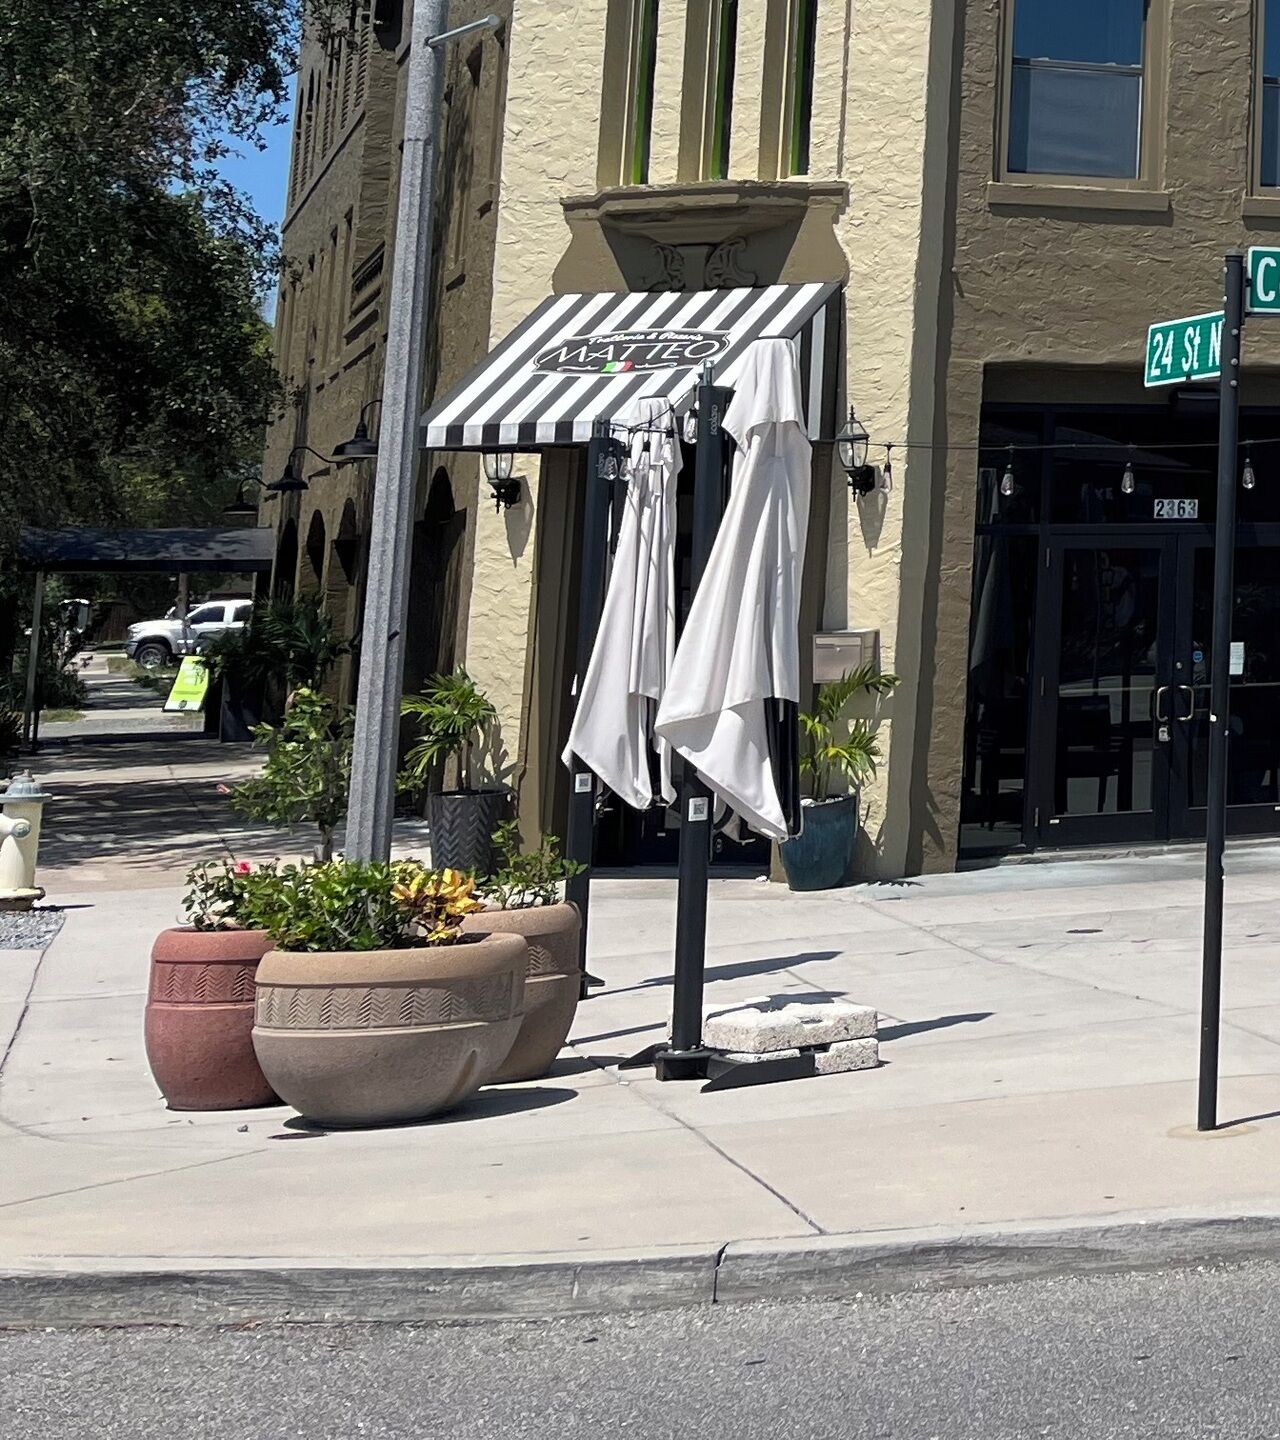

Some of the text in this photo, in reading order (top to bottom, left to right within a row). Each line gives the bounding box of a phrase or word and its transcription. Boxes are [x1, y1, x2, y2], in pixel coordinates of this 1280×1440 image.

[539, 340, 720, 363] MATTEO
[1150, 319, 1224, 377] 24 St N
[1155, 500, 1197, 518] 2363
